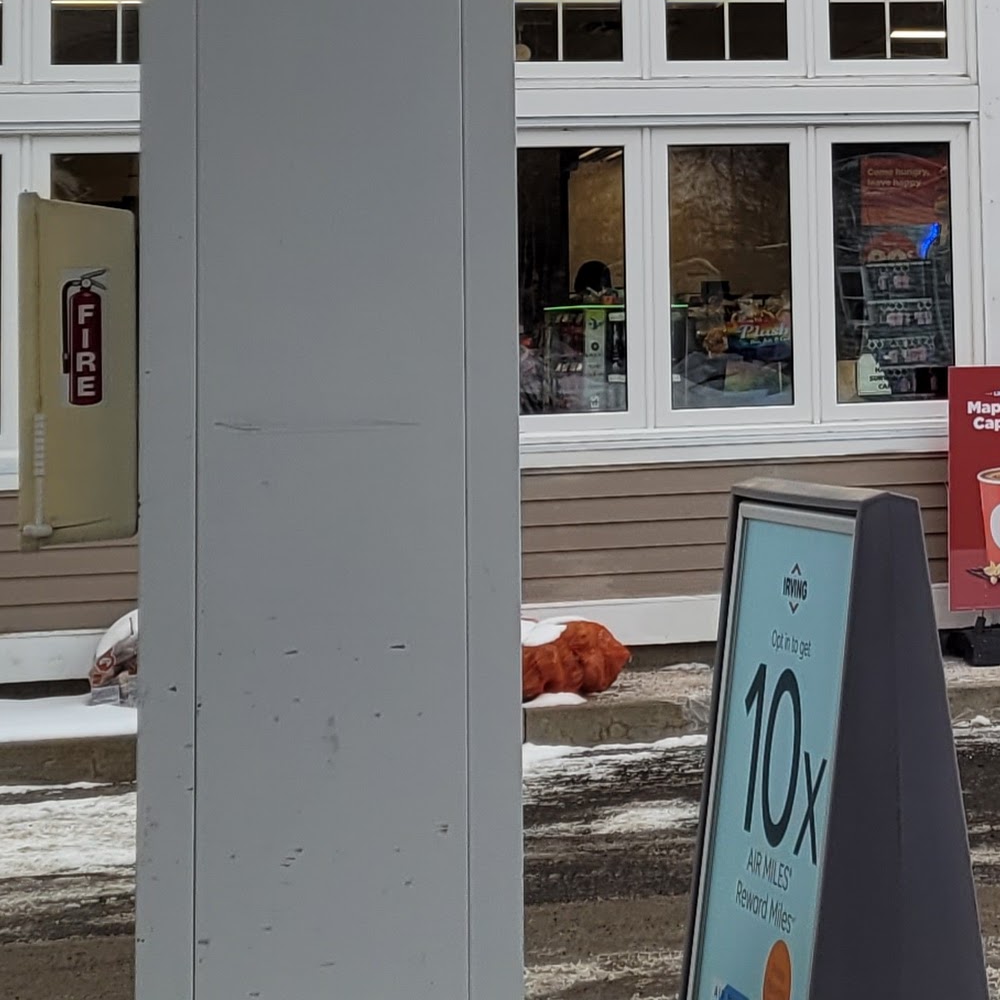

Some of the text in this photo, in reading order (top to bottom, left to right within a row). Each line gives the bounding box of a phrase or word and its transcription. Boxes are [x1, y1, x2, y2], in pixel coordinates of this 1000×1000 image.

[76, 304, 97, 397] FIRE
[783, 577, 808, 600] IRVING
[771, 629, 812, 660] Opt in to get
[746, 848, 762, 876] AIR
[735, 880, 769, 920] Reward
